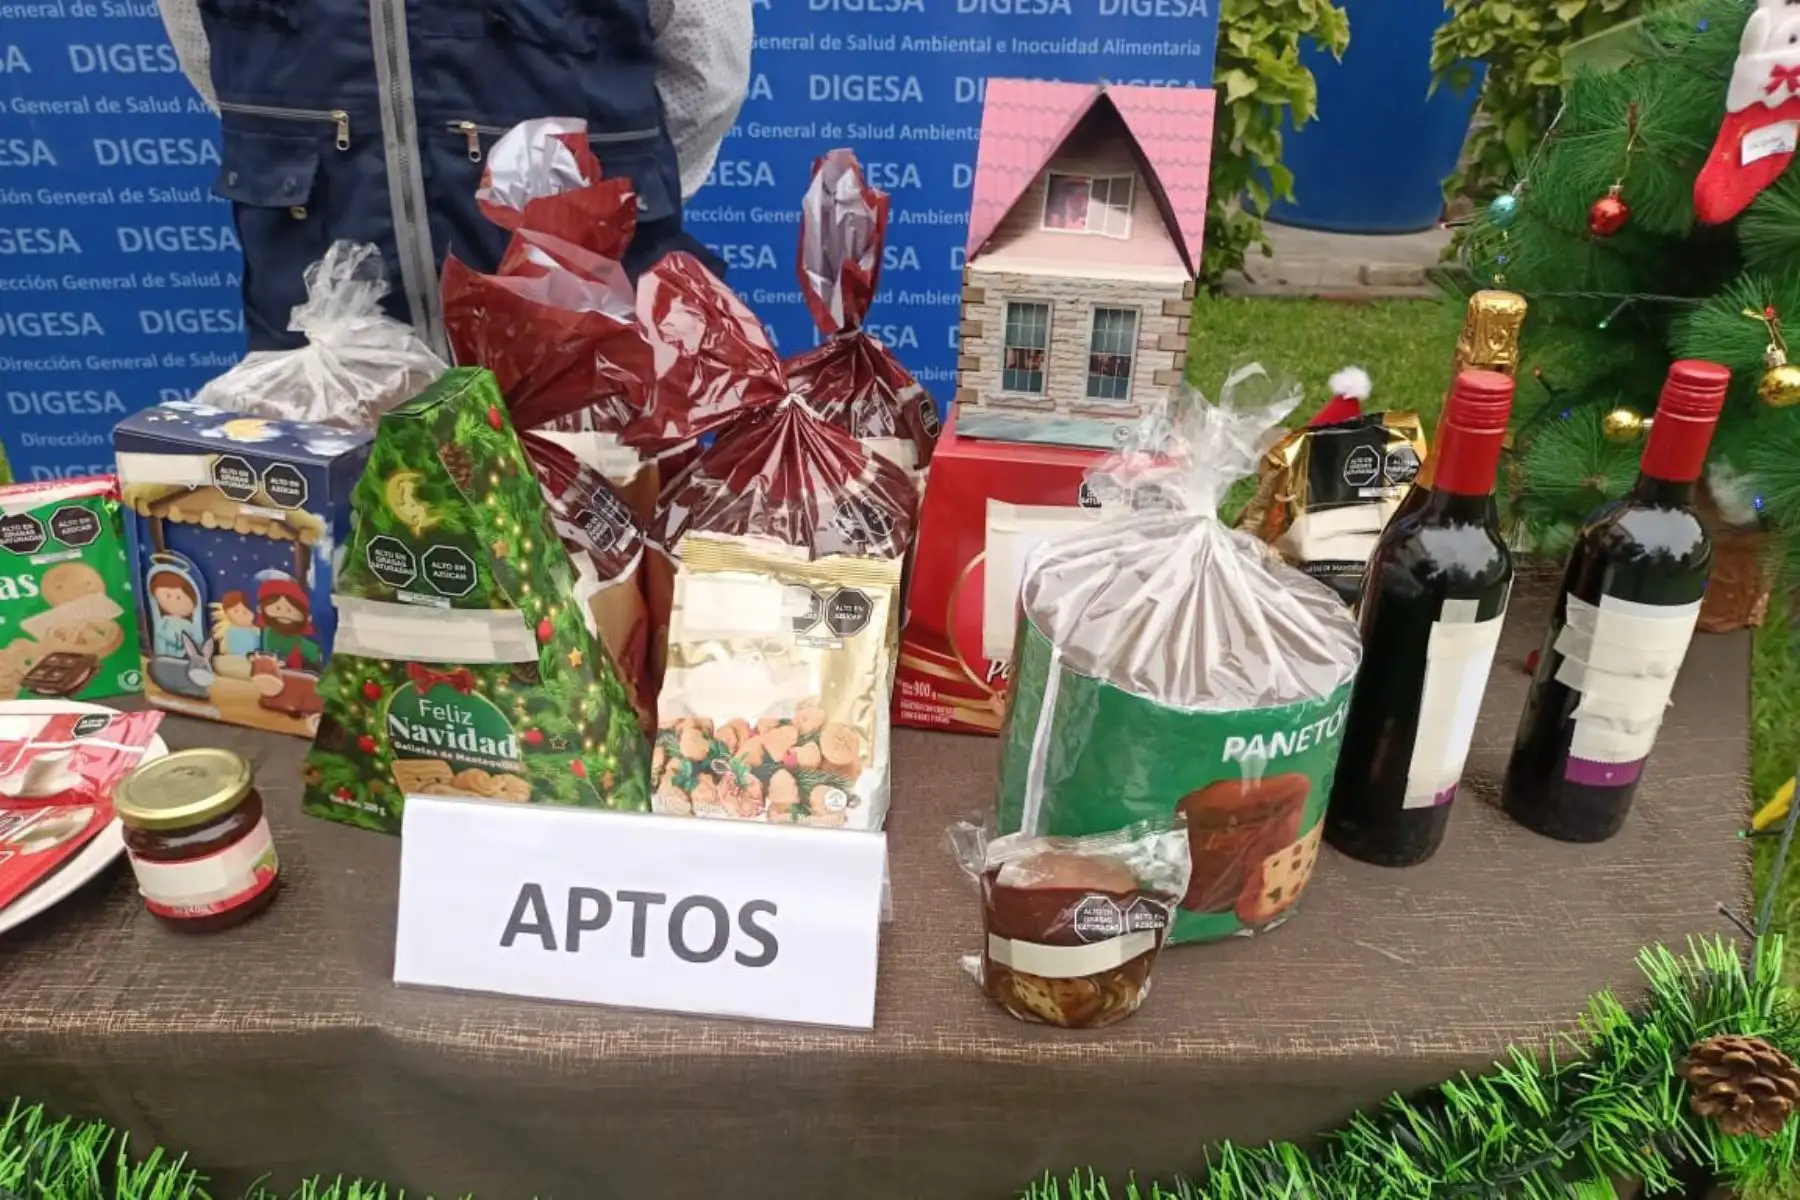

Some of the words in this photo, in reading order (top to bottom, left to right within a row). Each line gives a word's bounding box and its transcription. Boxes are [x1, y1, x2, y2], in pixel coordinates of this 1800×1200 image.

[0, 0, 65, 18] eneral
[70, 0, 97, 18] de
[820, 33, 842, 50] de
[847, 34, 896, 51] Salud
[901, 34, 991, 53] Ambiental
[996, 40, 1007, 53] e
[1012, 37, 1099, 55] Inocuidad
[1102, 39, 1201, 57] Alimentaria
[68, 44, 184, 74] DIGES
[809, 74, 923, 103] DIGESA
[11, 96, 90, 115] General
[95, 96, 121, 114] de
[126, 96, 181, 114] Salud
[747, 122, 816, 139] General
[820, 122, 842, 139] de
[847, 123, 895, 140] Salud
[92, 138, 222, 167] DIGESA
[866, 162, 922, 189] ESA
[37, 186, 115, 205] General
[119, 187, 145, 204] de
[148, 186, 201, 204] Salud
[684, 205, 746, 223] rección
[750, 206, 802, 224] Gener
[899, 208, 970, 225] Ambient
[0, 227, 83, 255] GESA
[116, 225, 242, 254] DIGESA
[0, 274, 59, 292] ección
[62, 274, 138, 291] General
[142, 272, 166, 290] de
[169, 271, 221, 290] Salud
[752, 288, 804, 304] Gener
[898, 289, 961, 305] Ambien
[0, 354, 83, 372] Dirección
[86, 352, 159, 370] General
[162, 351, 187, 369] de
[189, 350, 240, 368] Salud
[6, 390, 127, 415] DIGESA
[20, 431, 104, 448] Dirección
[0, 573, 40, 601] as
[418, 698, 474, 726] Feliz
[387, 712, 522, 760] Navidad
[394, 740, 438, 756] Galletas
[441, 750, 454, 760] de
[500, 882, 779, 968] APTOS
